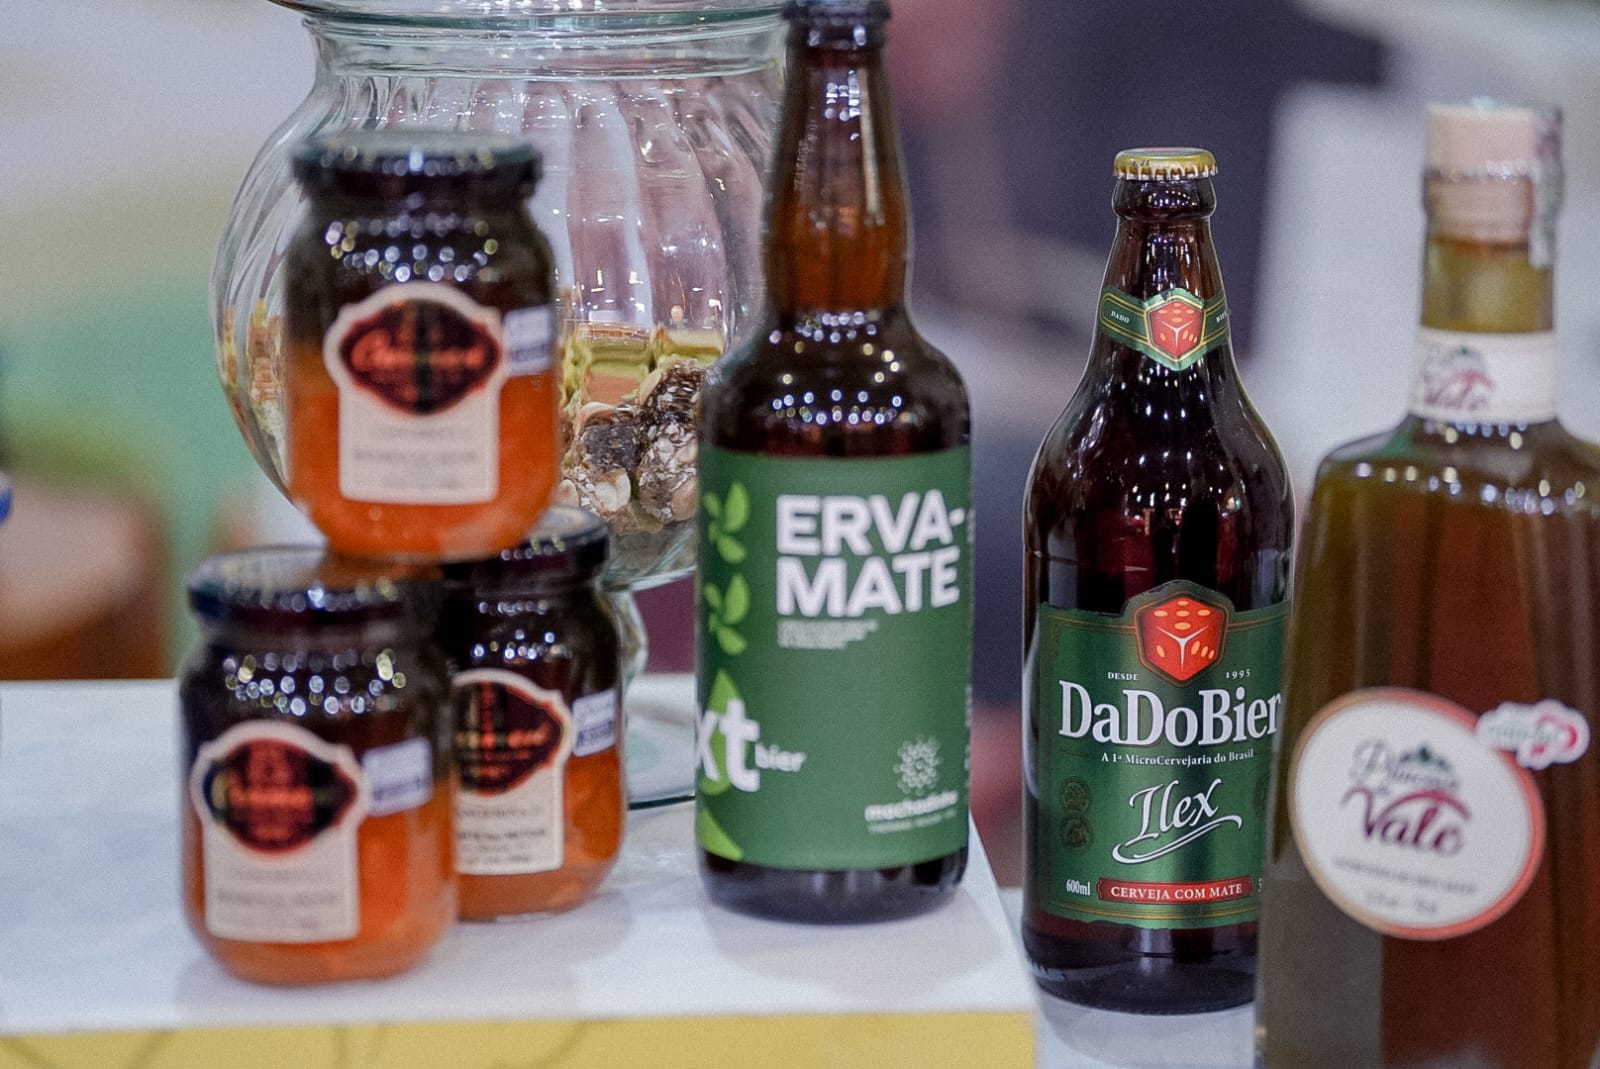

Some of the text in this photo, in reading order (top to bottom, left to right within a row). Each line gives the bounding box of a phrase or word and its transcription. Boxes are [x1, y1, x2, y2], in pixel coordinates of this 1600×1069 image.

[776, 488, 966, 556] ERVA-
[776, 545, 961, 618] MATE
[1107, 668, 1252, 681] DESDE 1995
[1058, 679, 1282, 747] DaDoBier
[1101, 752, 1109, 763] A
[1125, 754, 1212, 768] MicroCervejaria
[1214, 752, 1227, 763] do
[1228, 747, 1254, 762] Brasil
[1065, 878, 1091, 896] 600ml
[1110, 885, 1170, 900] CERVEJA
[1174, 885, 1206, 900] COM
[1208, 882, 1243, 899] MATE
